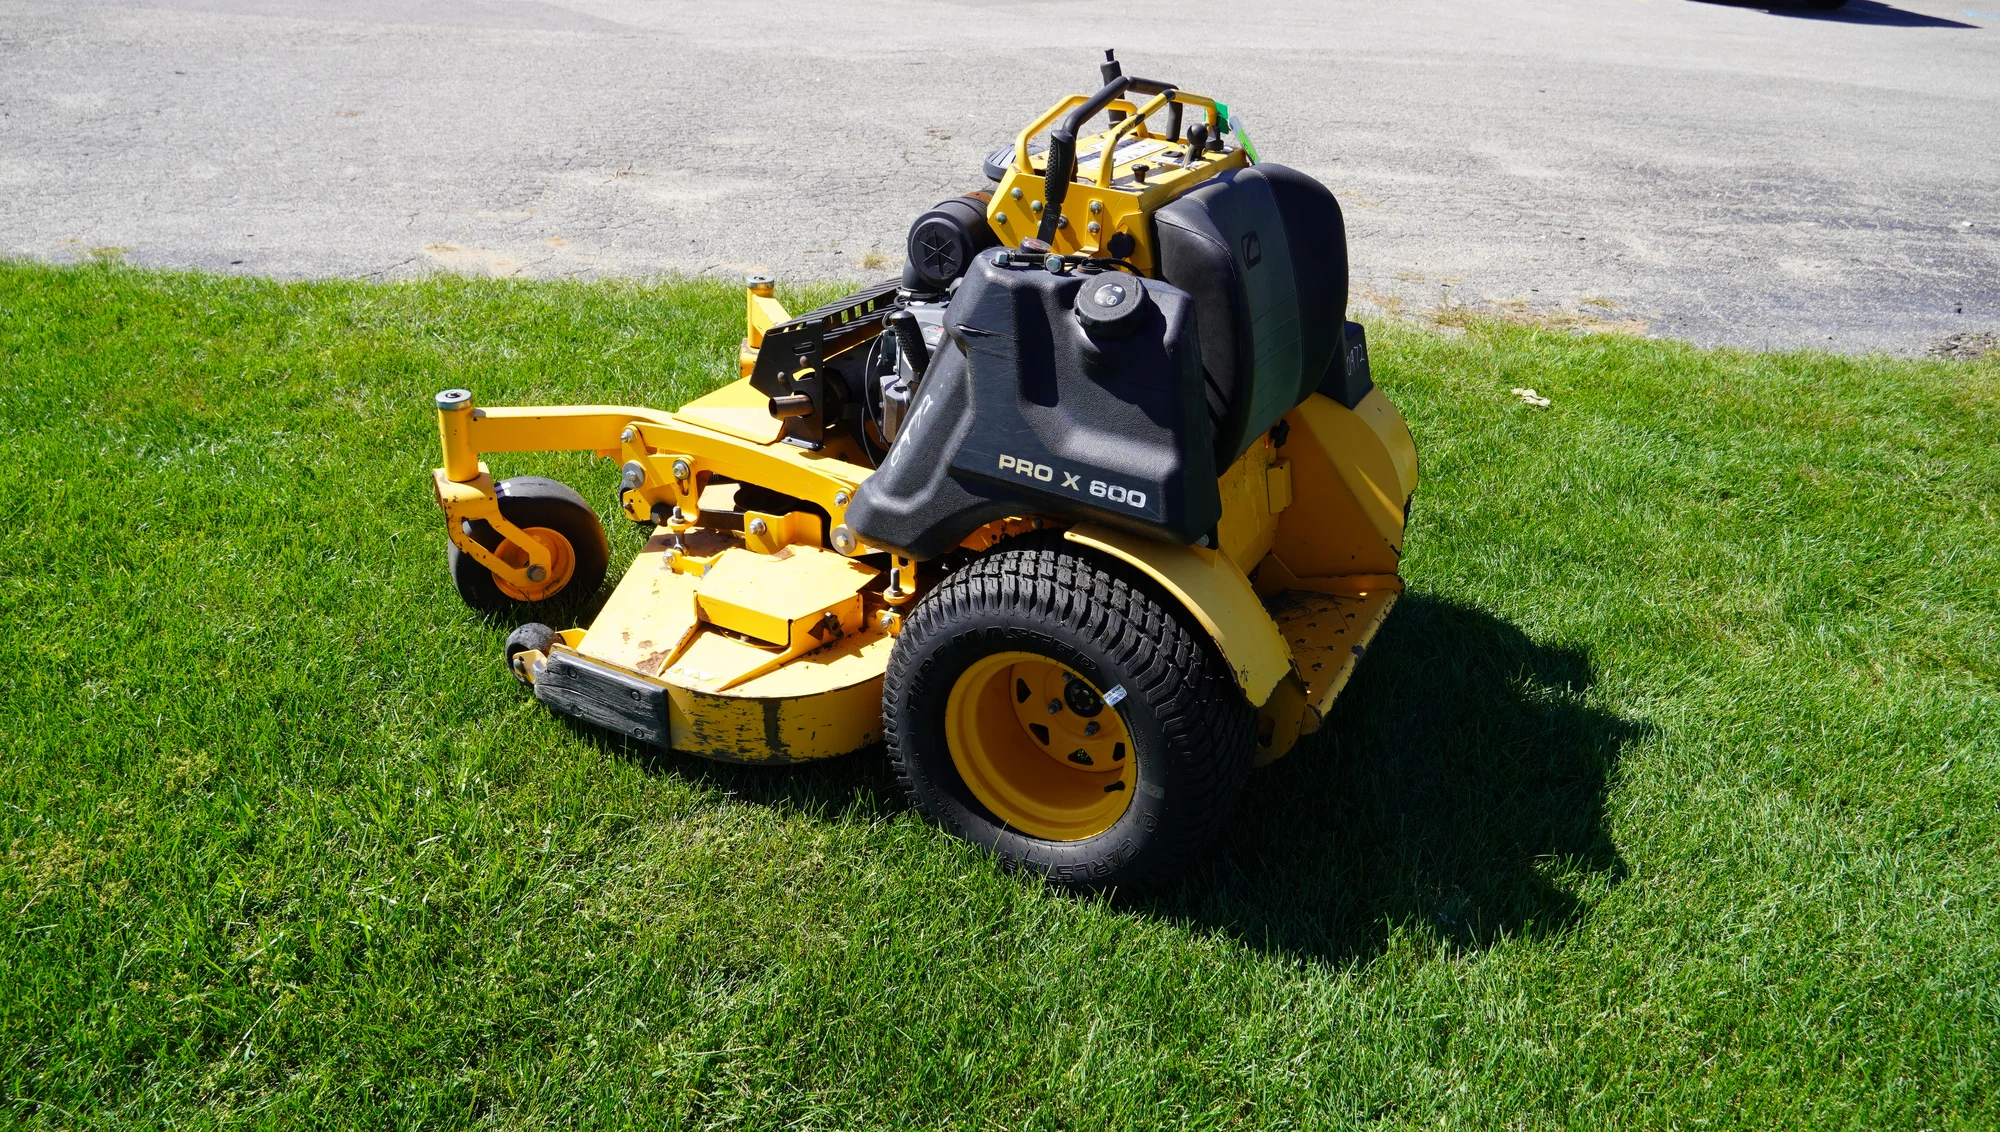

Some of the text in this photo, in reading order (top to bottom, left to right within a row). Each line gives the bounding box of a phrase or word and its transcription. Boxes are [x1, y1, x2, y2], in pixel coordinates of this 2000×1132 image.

[998, 454, 1147, 509] PRO X 600
[952, 626, 1097, 671] MASTER
